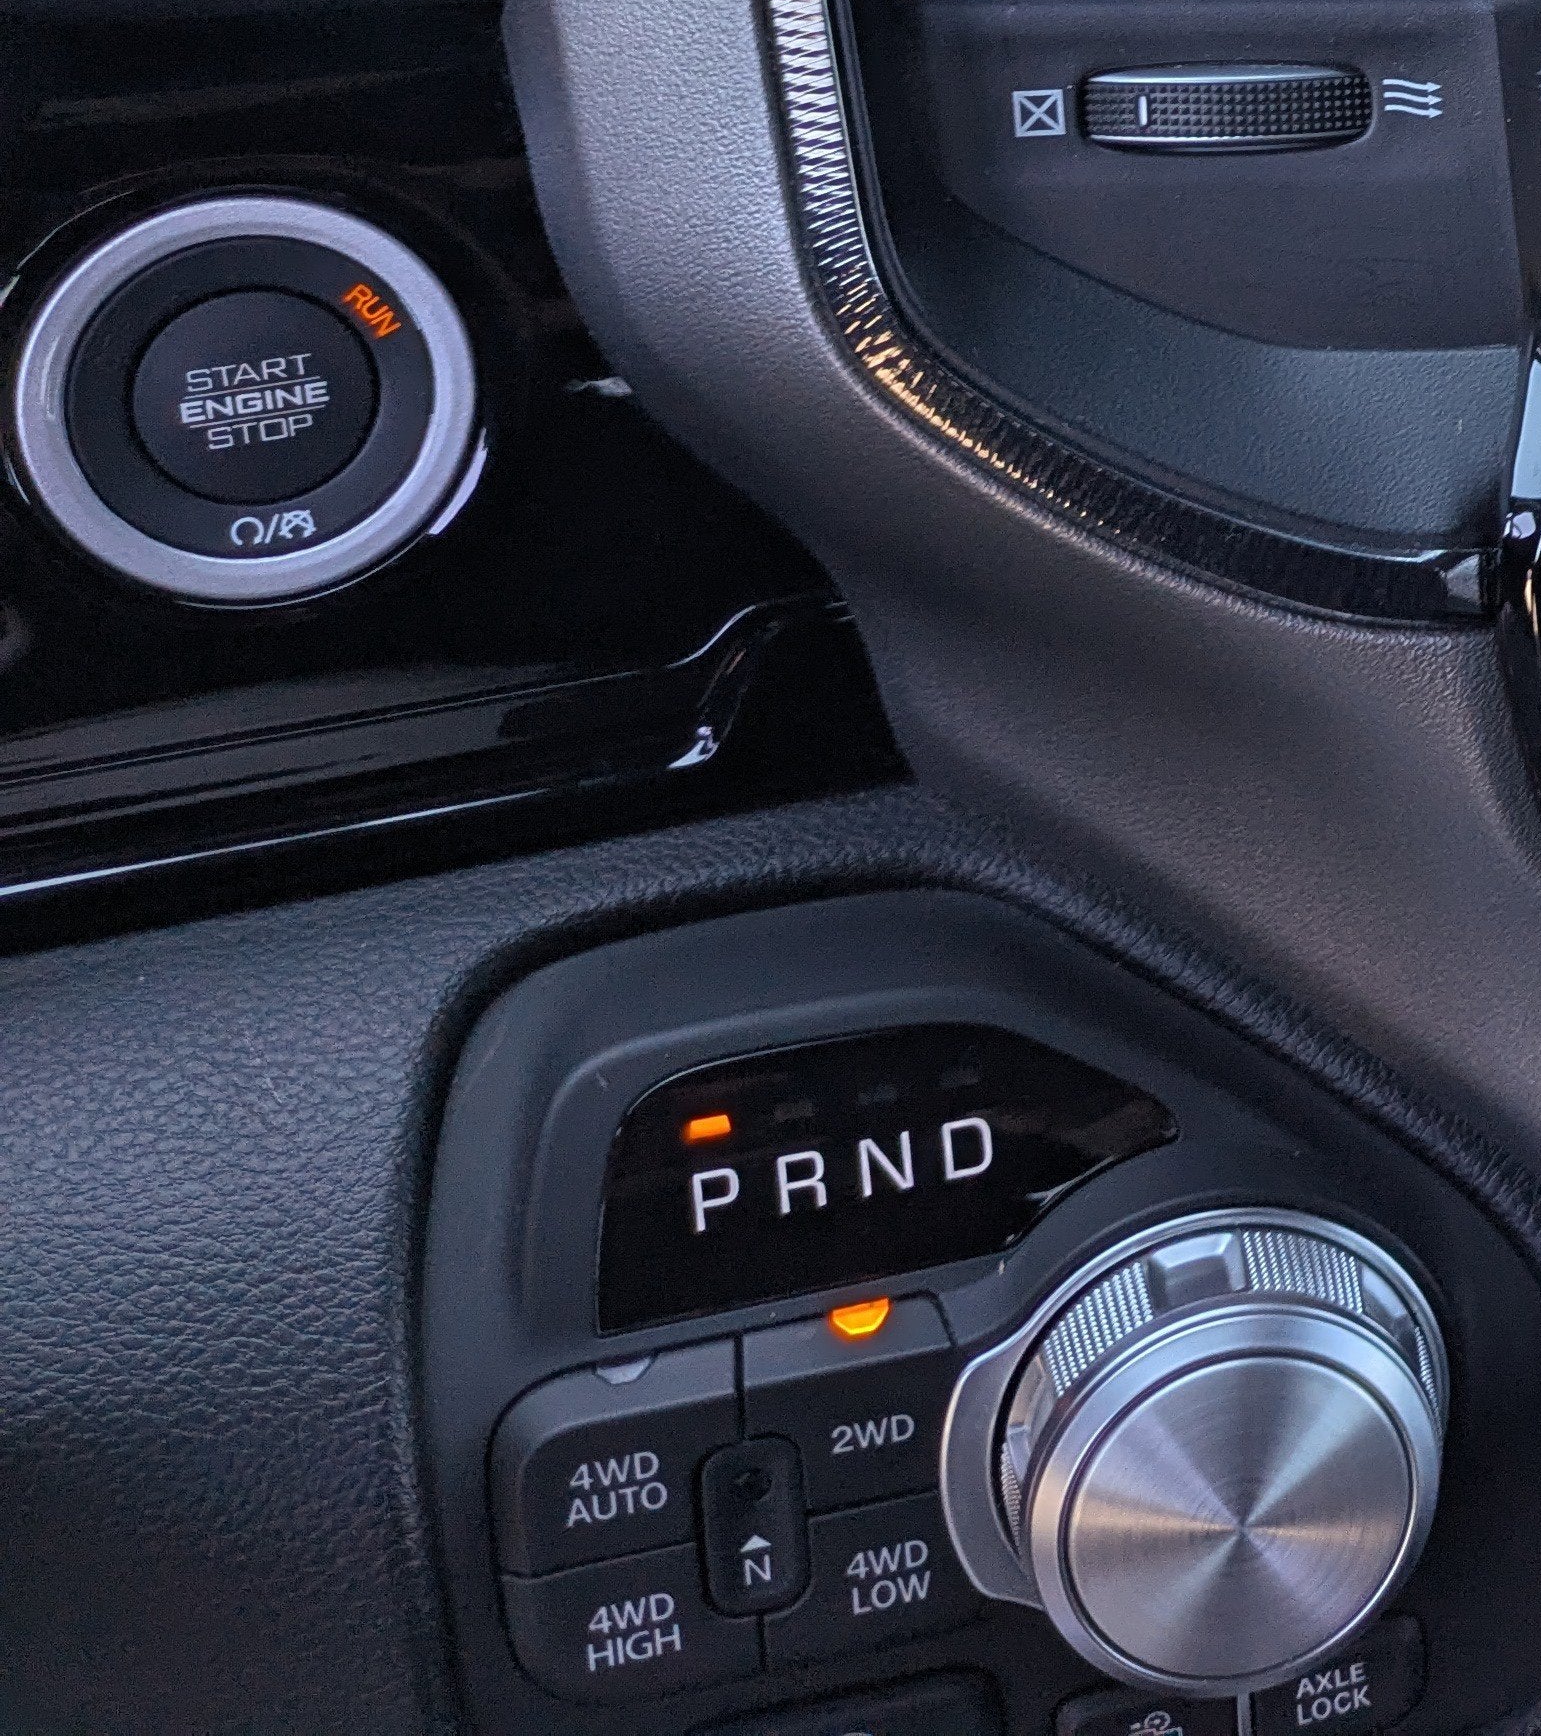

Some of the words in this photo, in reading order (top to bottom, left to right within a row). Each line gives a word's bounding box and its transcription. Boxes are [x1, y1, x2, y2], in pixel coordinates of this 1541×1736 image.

[342, 282, 403, 341] RUN
[185, 352, 313, 394] START
[179, 379, 331, 425] ENGINE
[206, 414, 314, 451] STOP
[830, 1413, 916, 1456] 2WD
[568, 1450, 660, 1492] 4WD
[565, 1480, 669, 1528] AUTO
[743, 1554, 773, 1587] N
[845, 1539, 930, 1582] 4WD
[587, 1592, 676, 1637] 4WD
[851, 1571, 933, 1617] LOW
[585, 1624, 684, 1673] HIGH
[1295, 1662, 1367, 1701] AXLE
[1296, 1685, 1373, 1727] LOCK
